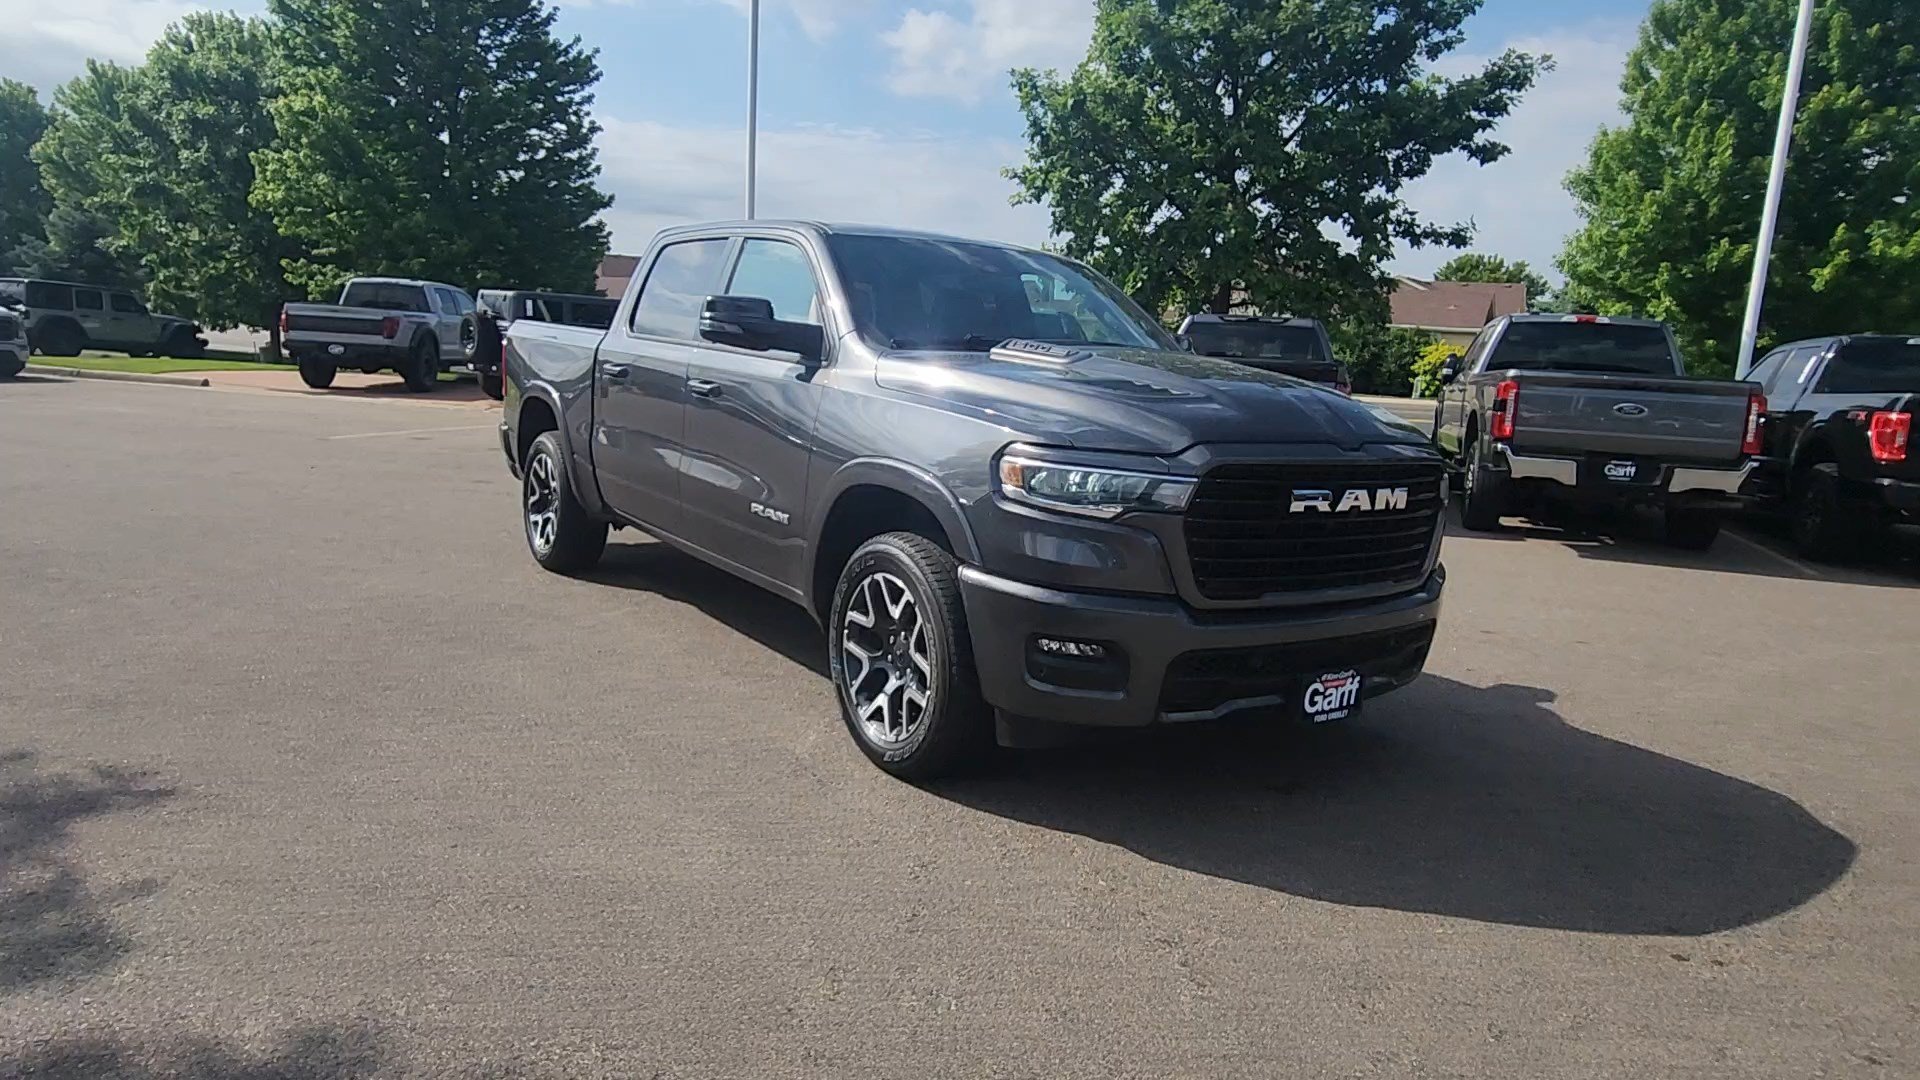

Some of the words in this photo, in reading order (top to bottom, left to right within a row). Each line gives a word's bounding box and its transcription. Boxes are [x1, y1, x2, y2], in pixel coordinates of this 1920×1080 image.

[1604, 464, 1636, 477] Garff
[1289, 487, 1408, 513] RAM
[750, 502, 790, 525] RAM
[1304, 676, 1361, 713] Garff
